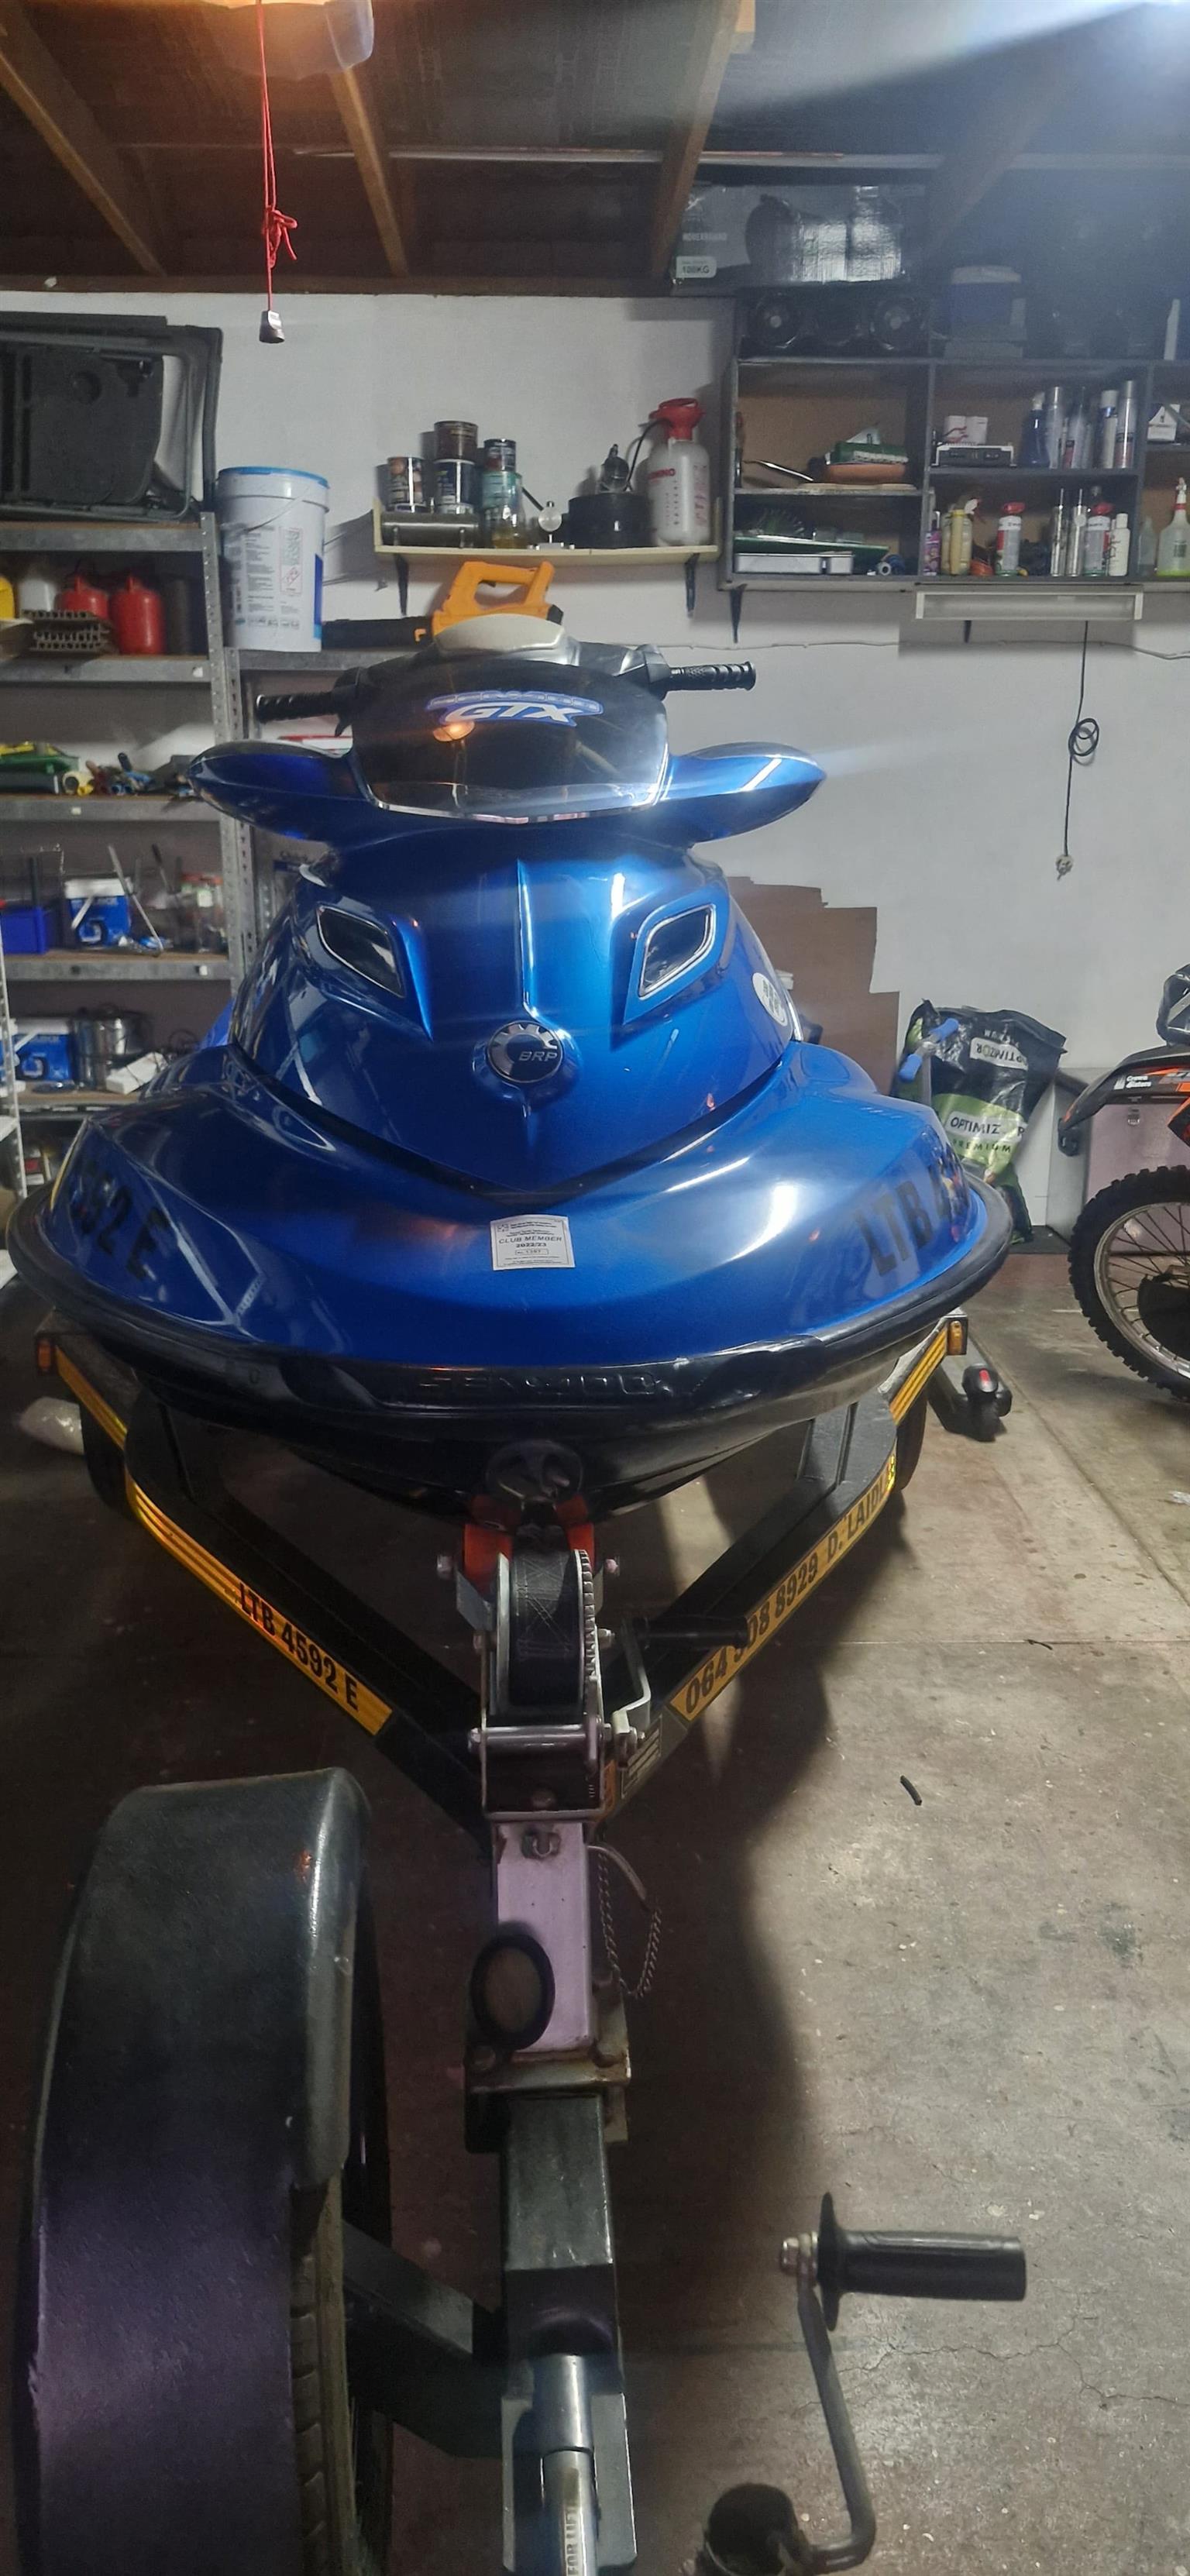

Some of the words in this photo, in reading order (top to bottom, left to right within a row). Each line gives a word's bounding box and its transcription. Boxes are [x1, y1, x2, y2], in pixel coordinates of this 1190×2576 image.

[445, 702, 583, 722] GTX
[519, 1051, 558, 1061] BRP
[950, 1116, 1026, 1137] OPTIMIZR
[686, 1647, 727, 1714] 064
[776, 1552, 818, 1618] 8929
[240, 1582, 276, 1636] LTB
[282, 1622, 339, 1694] 4592
[345, 1673, 359, 1712] E
